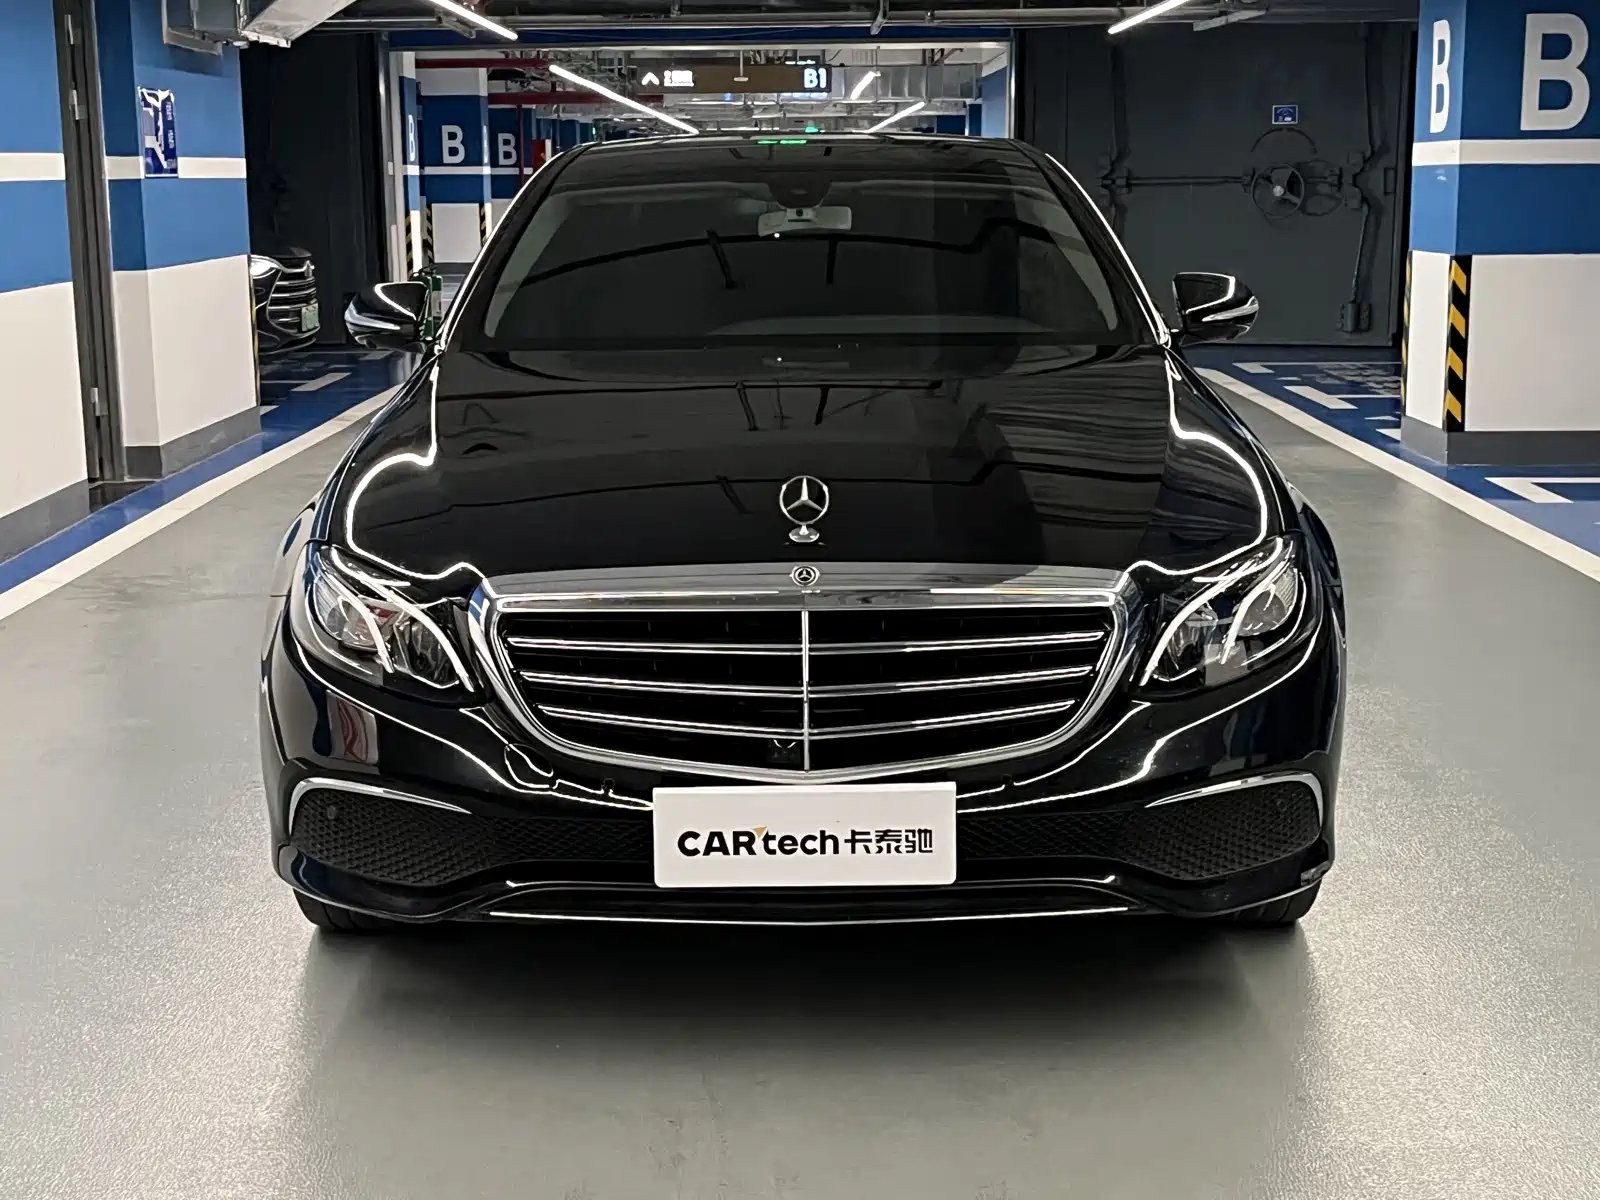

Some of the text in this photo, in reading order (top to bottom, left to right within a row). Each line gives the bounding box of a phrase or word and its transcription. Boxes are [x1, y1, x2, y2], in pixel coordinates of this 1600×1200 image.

[803, 67, 827, 89] B1
[1430, 19, 1451, 133] B
[1520, 13, 1590, 131] B
[441, 125, 465, 164] B
[497, 133, 517, 166] B
[844, 828, 934, 855] 卡泰驰
